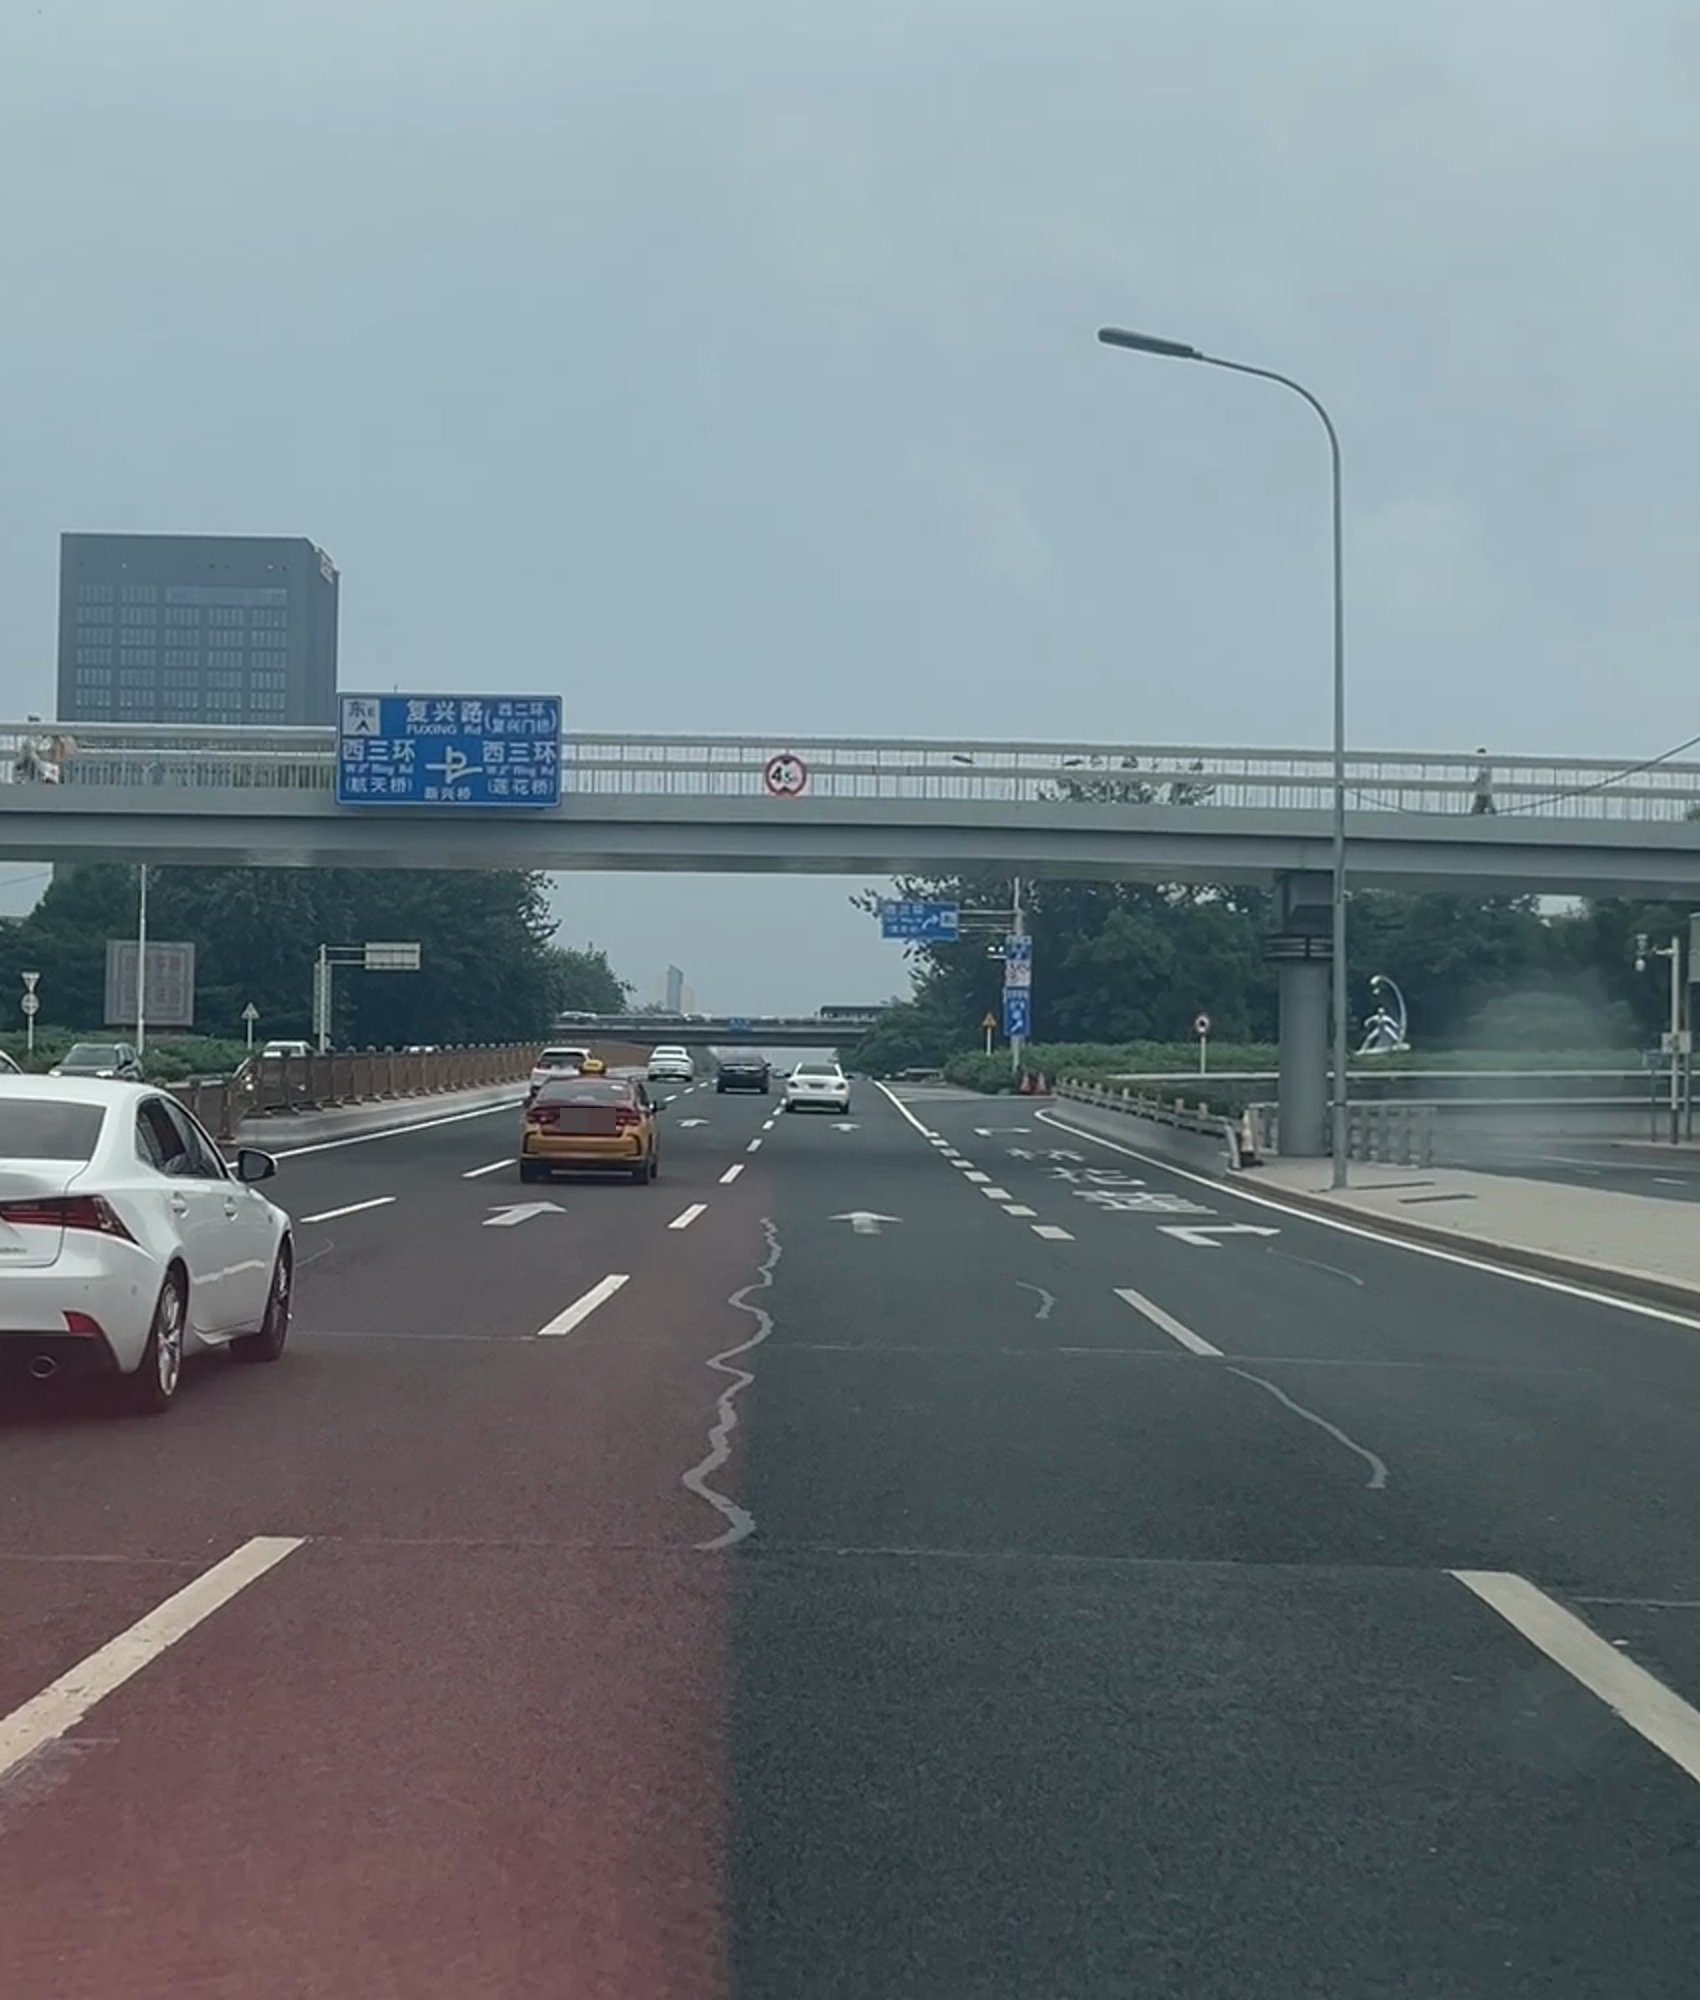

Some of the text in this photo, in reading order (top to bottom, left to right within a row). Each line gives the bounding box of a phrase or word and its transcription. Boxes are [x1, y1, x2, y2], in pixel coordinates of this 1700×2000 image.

[406, 699, 483, 723] 复兴路
[406, 723, 457, 735] FUXING
[342, 738, 416, 763] 西三环
[482, 740, 556, 764] 西三环
